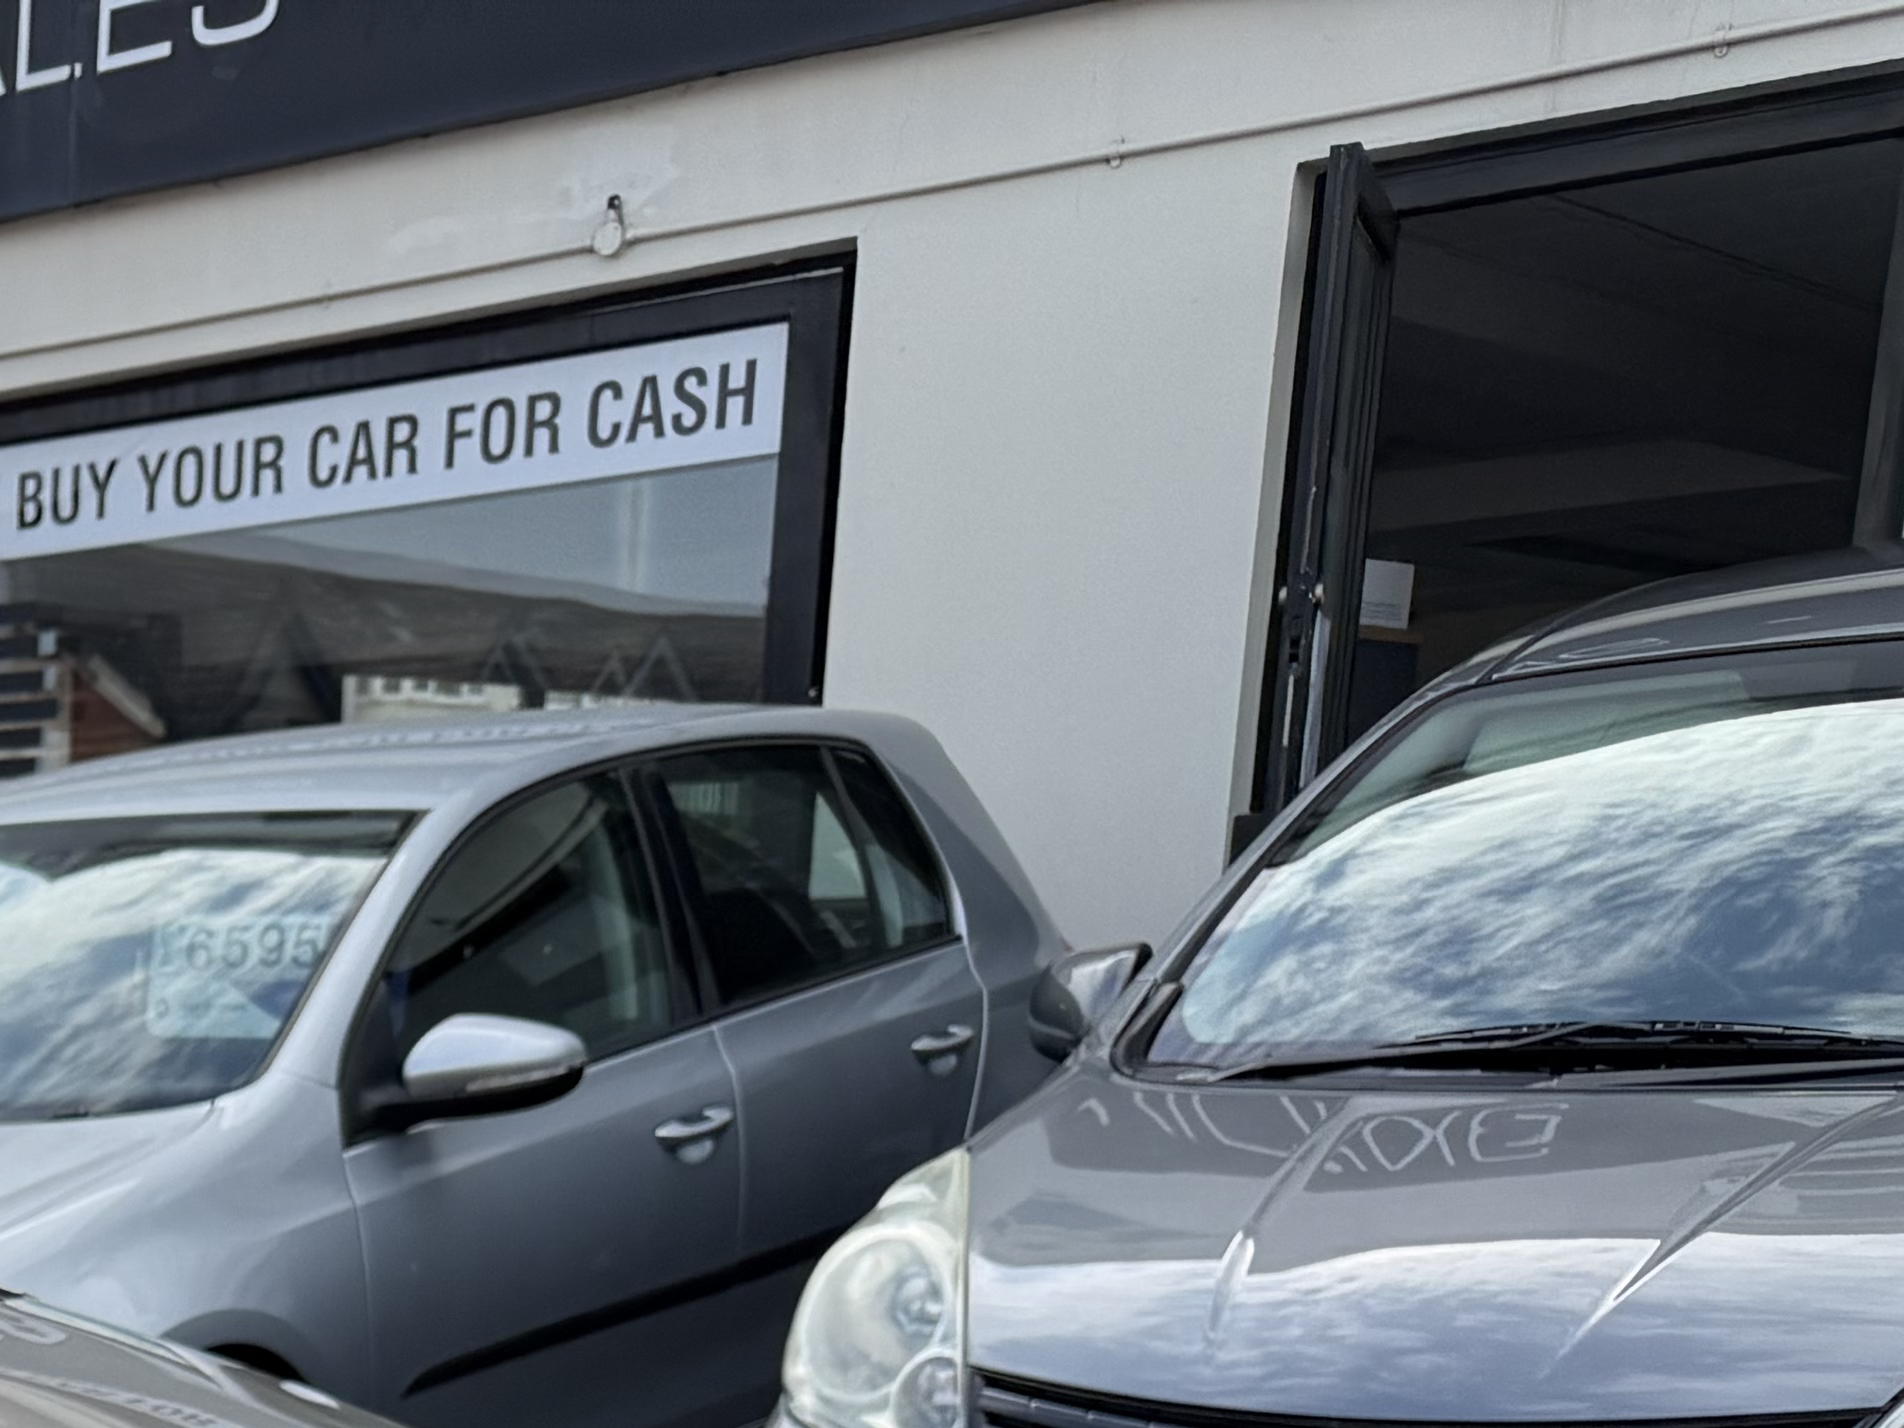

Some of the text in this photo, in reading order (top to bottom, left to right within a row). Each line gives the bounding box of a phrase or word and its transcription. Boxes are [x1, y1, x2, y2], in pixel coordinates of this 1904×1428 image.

[16, 457, 119, 531] BUY
[138, 434, 285, 513] YOUR
[308, 413, 420, 489] CAR
[444, 390, 563, 470] FOR
[587, 358, 759, 449] CASH
